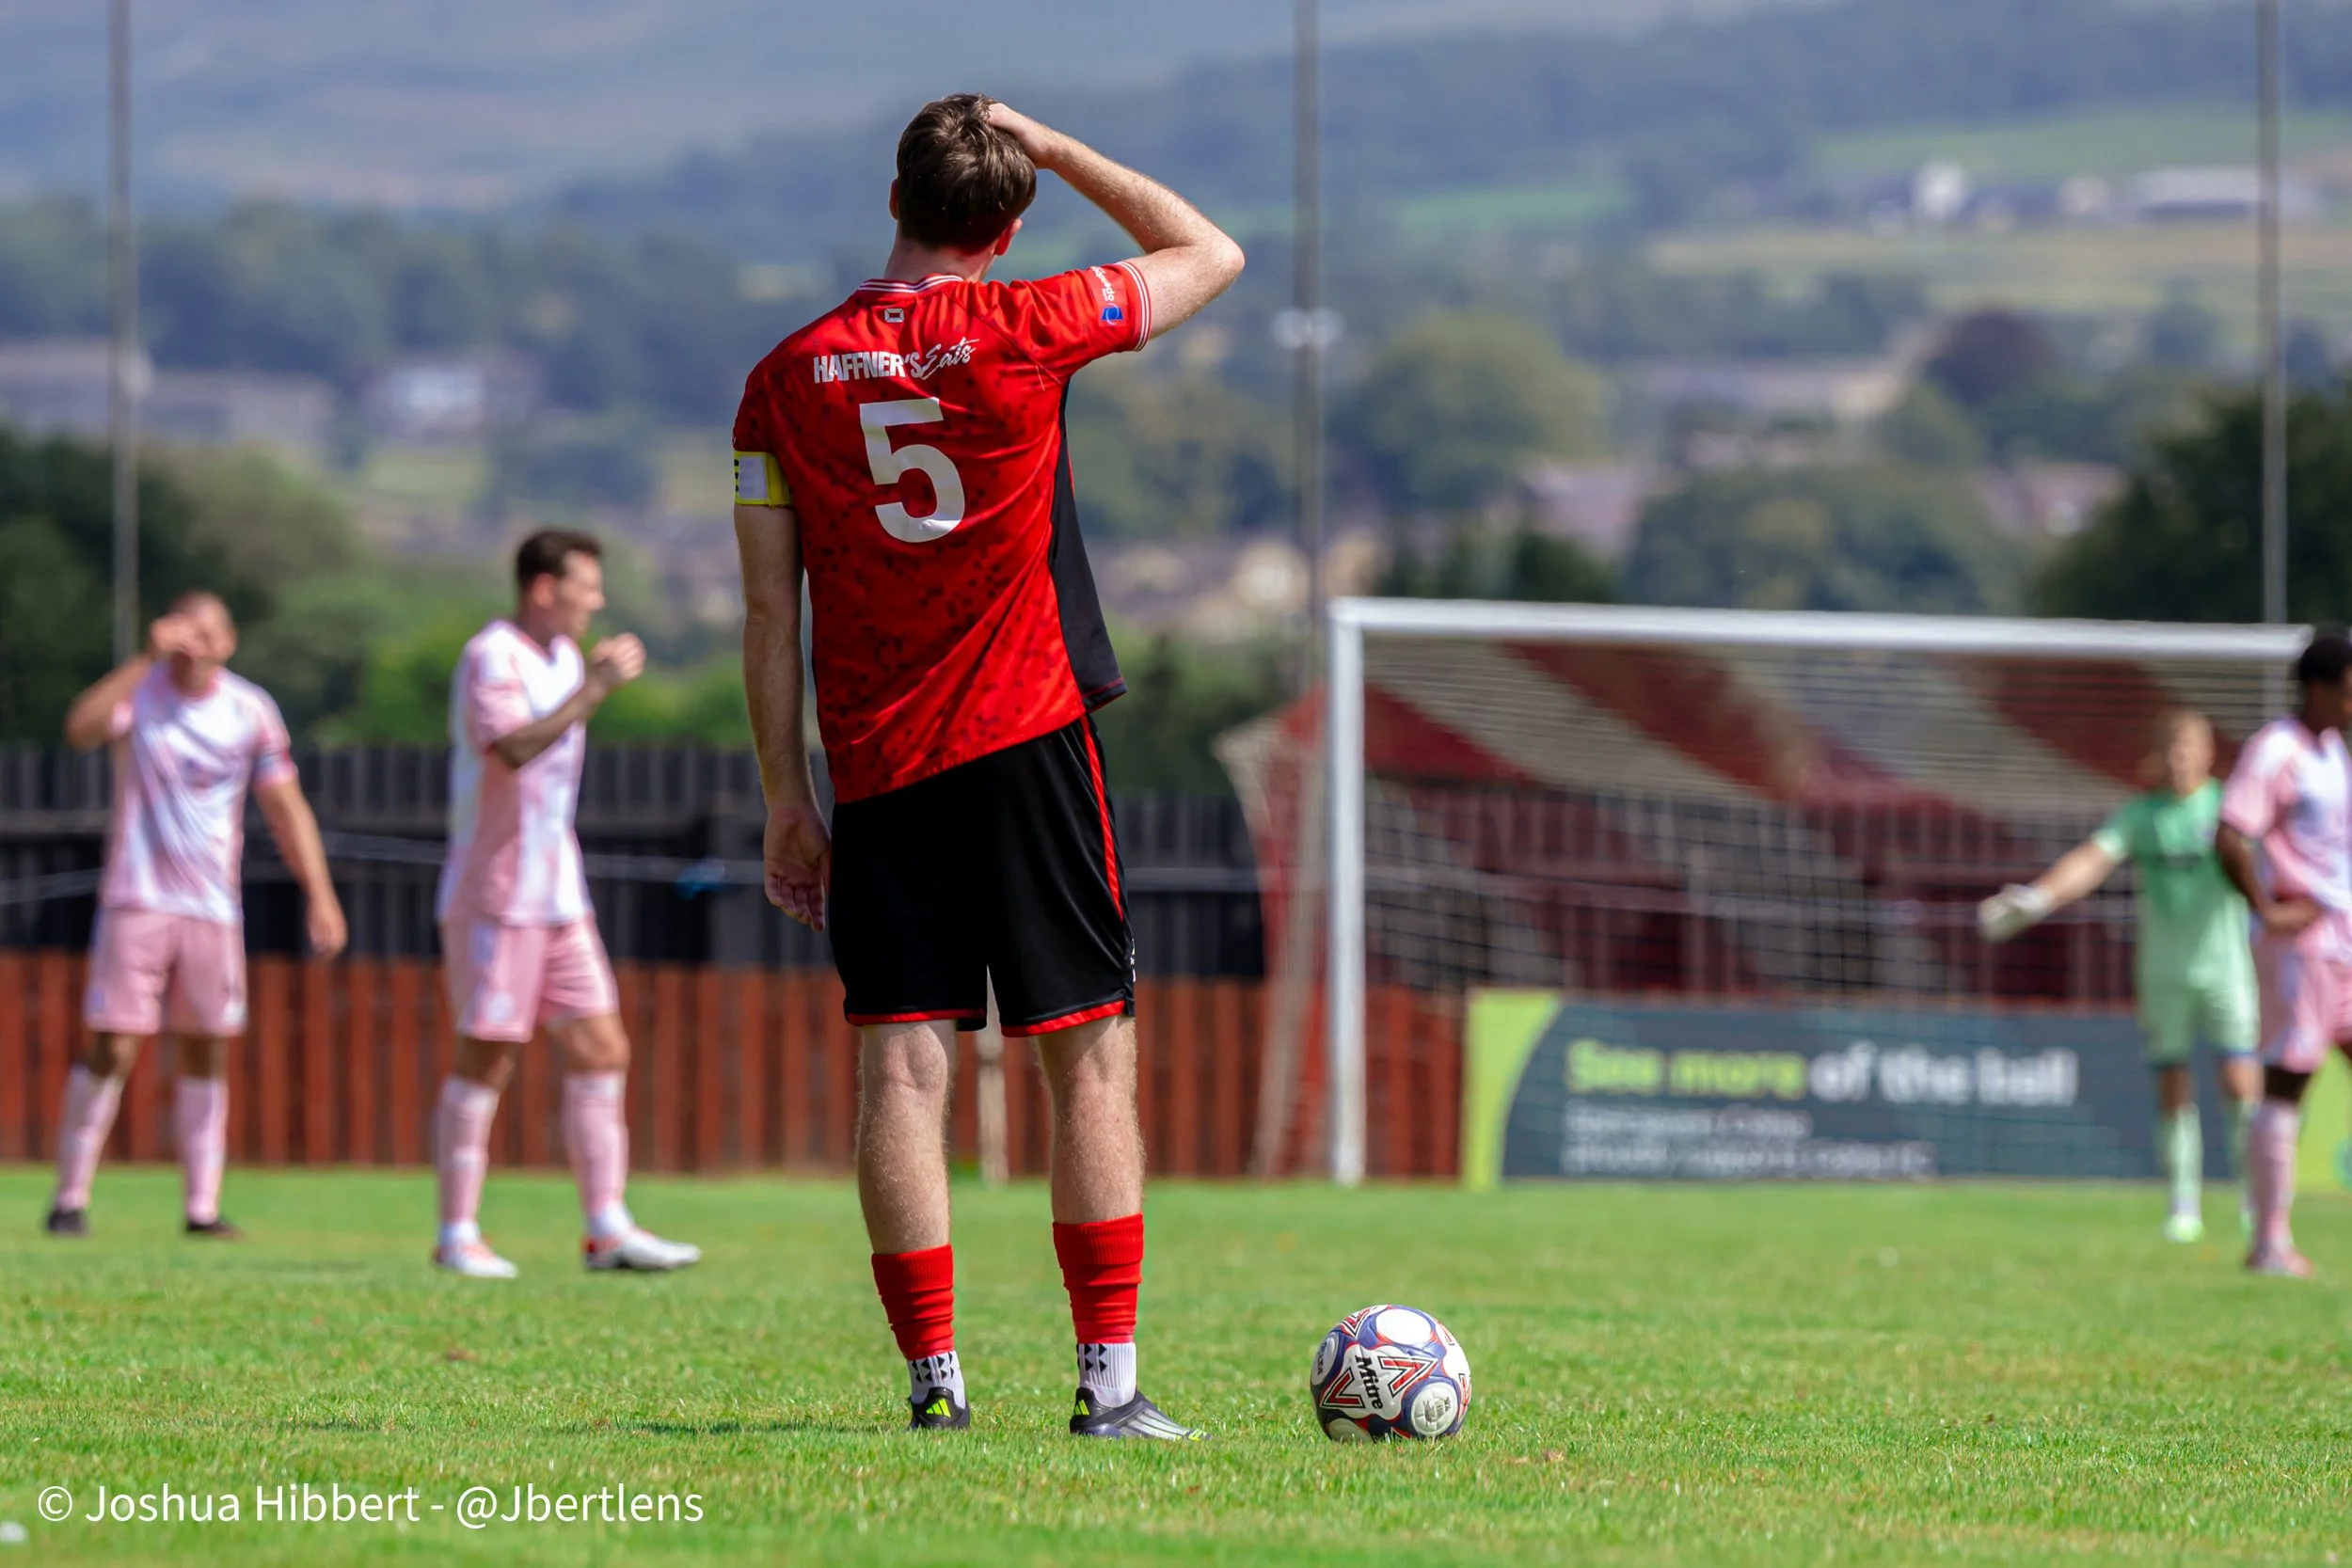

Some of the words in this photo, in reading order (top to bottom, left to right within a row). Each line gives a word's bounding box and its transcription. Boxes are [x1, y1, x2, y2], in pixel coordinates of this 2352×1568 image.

[814, 351, 922, 384] HAFFNER'S
[920, 337, 980, 380] Eats
[859, 396, 965, 543] 5
[1569, 1041, 1661, 1093] See
[1669, 1051, 1806, 1100] more
[1809, 1040, 1877, 1102] of
[1881, 1045, 1972, 1105] the
[1979, 1046, 2076, 1108] ball
[1355, 1355, 1383, 1409] Mitre
